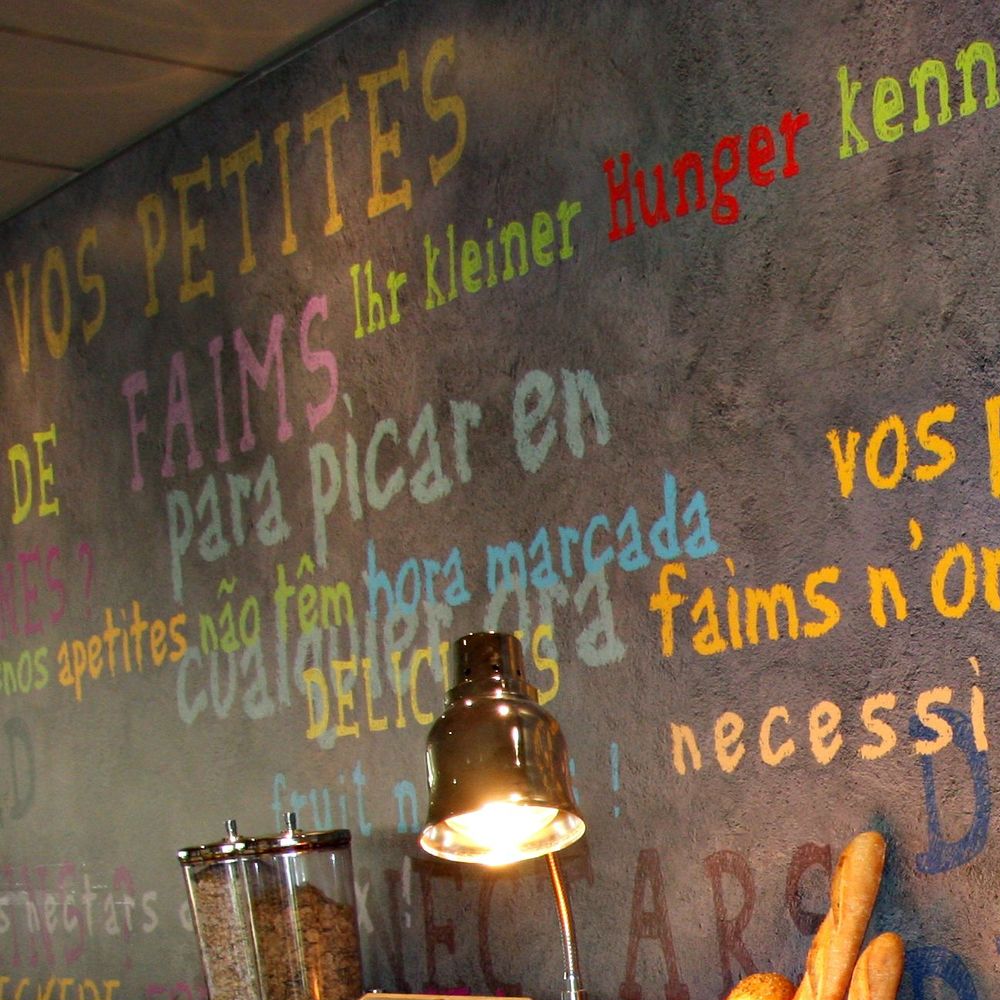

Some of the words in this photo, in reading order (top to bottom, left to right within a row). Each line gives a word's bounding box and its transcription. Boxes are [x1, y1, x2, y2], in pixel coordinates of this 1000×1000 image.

[2, 227, 106, 375] VOS
[135, 34, 470, 318] PETITES
[349, 259, 408, 340] Ihr
[422, 198, 582, 311] kleiner
[602, 110, 810, 242] Hunger
[8, 423, 60, 525] DE
[121, 293, 341, 492] FAIMS
[166, 452, 292, 606] para
[308, 393, 483, 568] picar
[512, 368, 611, 474] en
[827, 404, 957, 498] vos
[57, 599, 190, 702] apetites
[200, 576, 261, 655] não
[274, 552, 354, 642] têm
[367, 539, 473, 621] hora
[486, 470, 720, 592] marcada
[649, 557, 842, 658] faims
